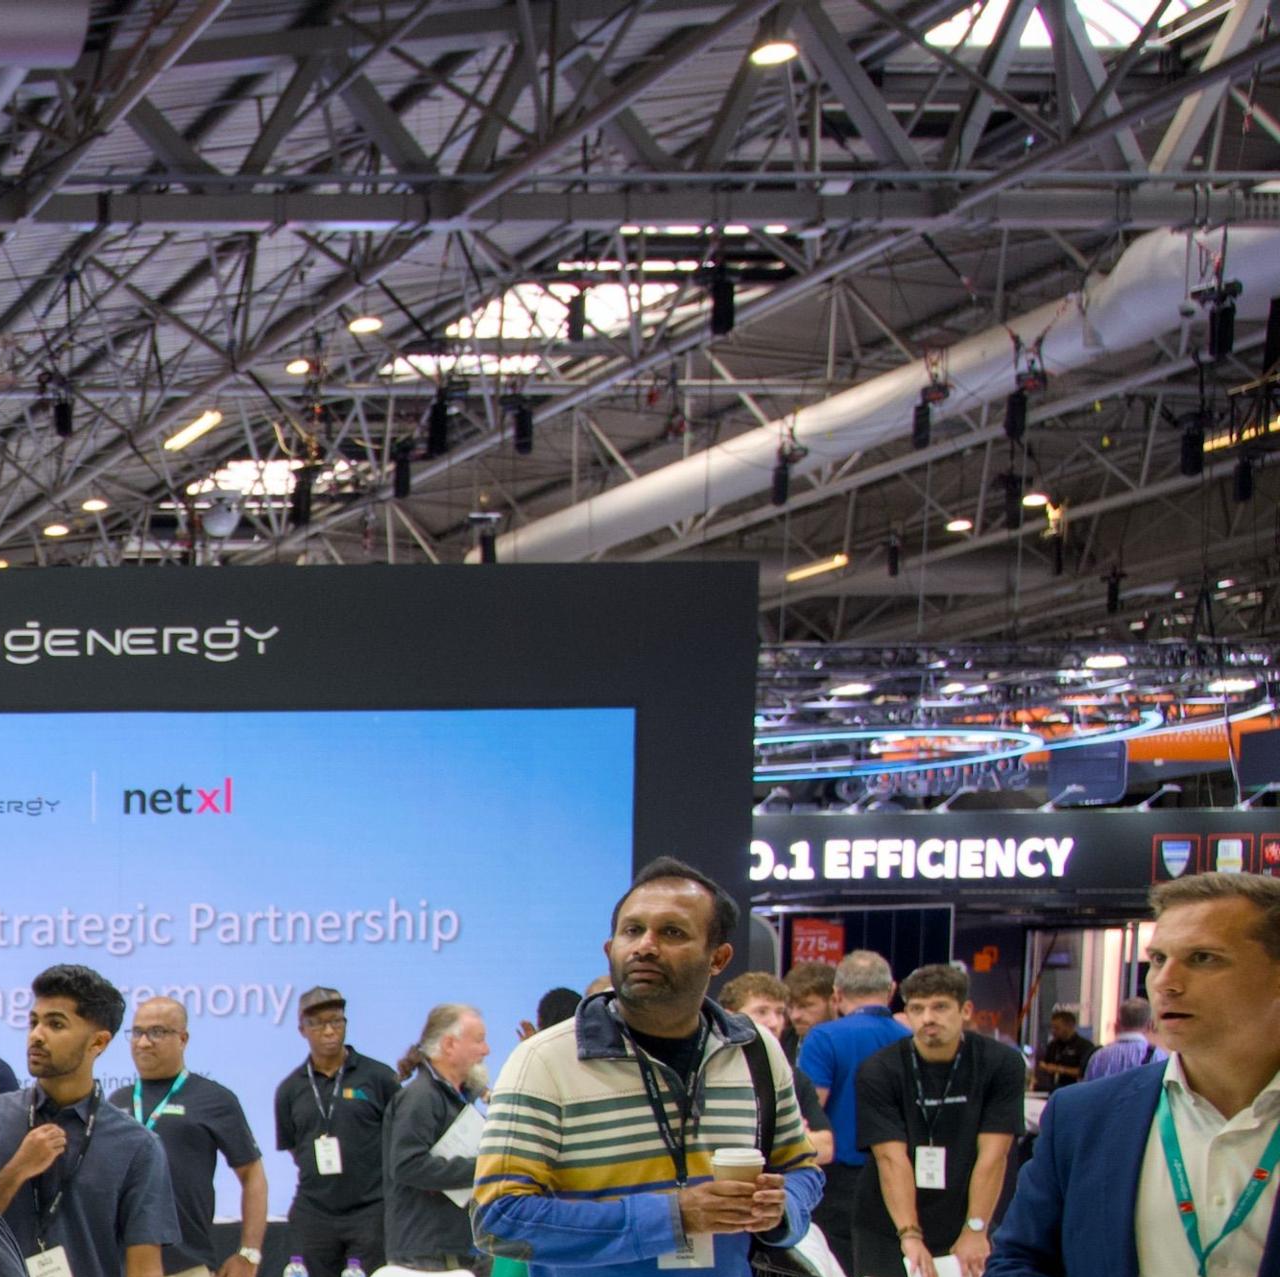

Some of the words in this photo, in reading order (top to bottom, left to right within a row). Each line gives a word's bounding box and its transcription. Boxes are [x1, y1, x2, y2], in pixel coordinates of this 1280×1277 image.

[123, 776, 233, 815] netxl
[749, 840, 816, 881] O.1
[824, 838, 1075, 880] EFFICIENCY
[188, 897, 460, 952] Partnership
[117, 980, 295, 1026] remony
